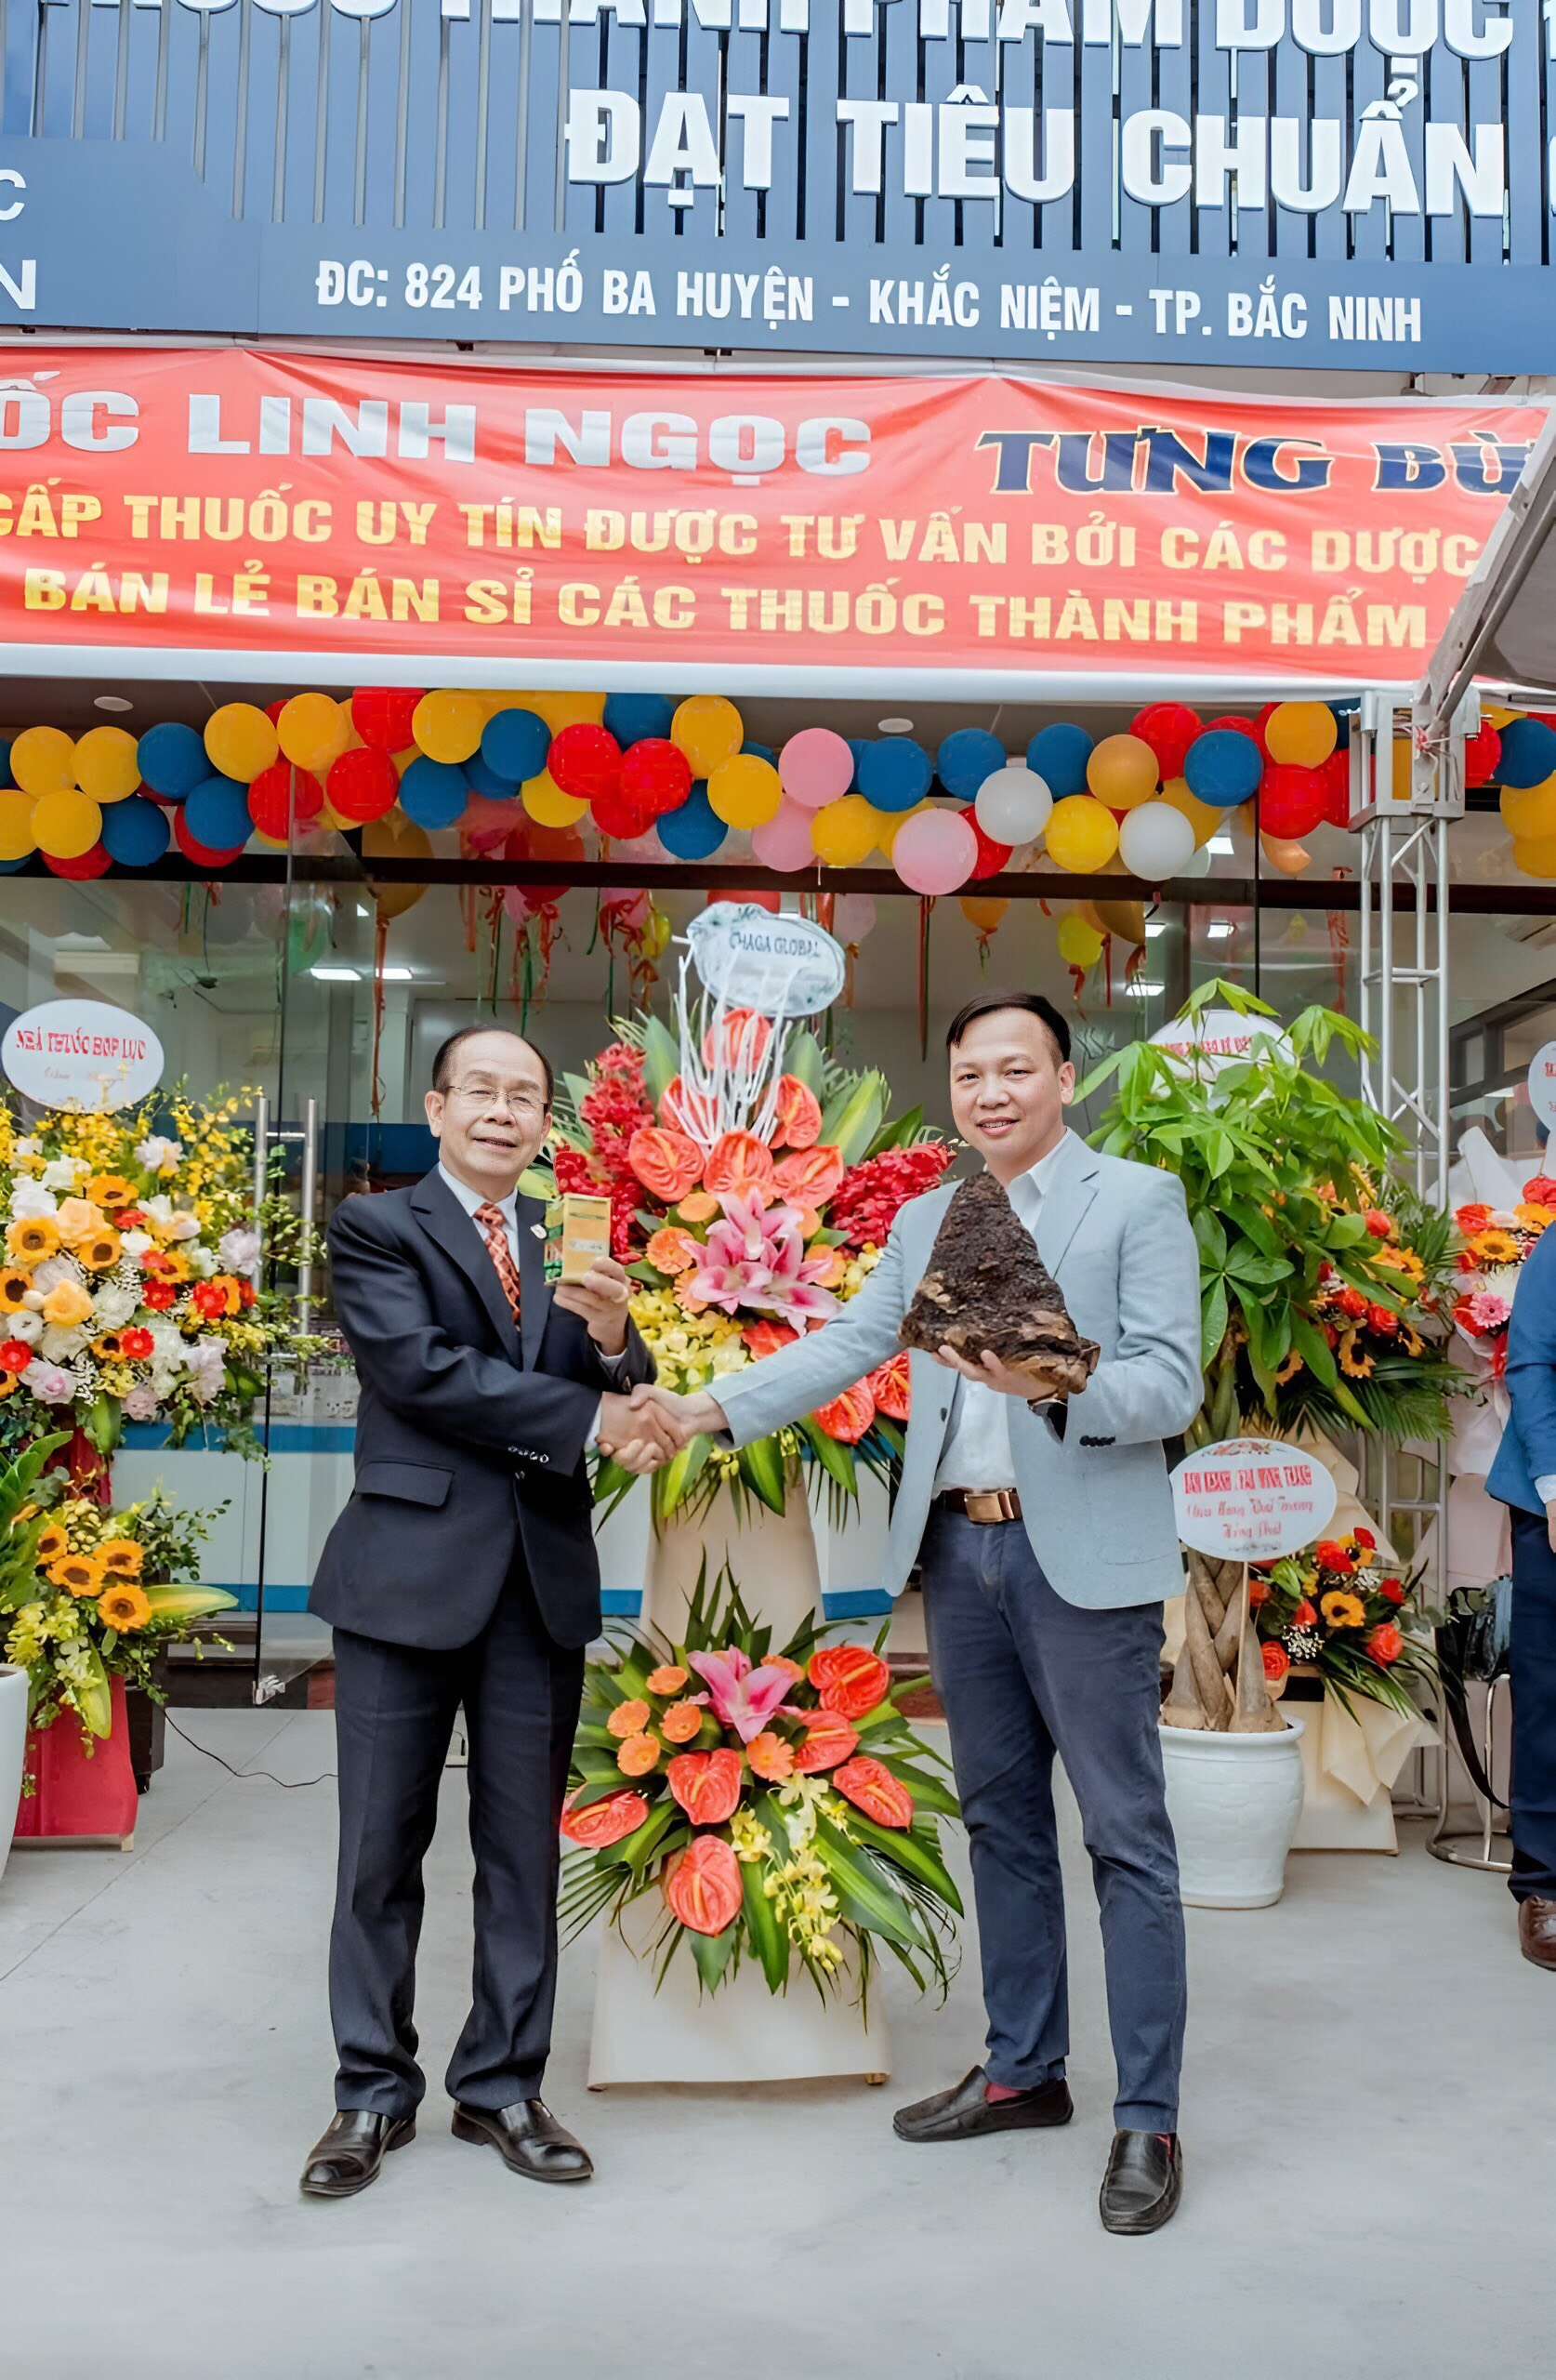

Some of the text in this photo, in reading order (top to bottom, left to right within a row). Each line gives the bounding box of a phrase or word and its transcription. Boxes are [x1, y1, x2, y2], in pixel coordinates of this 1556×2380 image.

[564, 88, 790, 209] ĐẠT
[837, 85, 1075, 204] TIÊU
[1122, 79, 1505, 217] CHUẨN
[314, 248, 1421, 342] ĐC: 824 PHỐ BA HUYỆN - KHẮC NIỆM - TP. BẮC NINH
[189, 394, 476, 464] LINH
[525, 409, 870, 486] NGỌC
[124, 483, 333, 543] THUỐC
[357, 501, 438, 546] UY
[458, 496, 562, 549] TÍN
[584, 509, 758, 564] ĐƯỢC
[781, 514, 865, 560] TƯ
[880, 506, 1008, 564] VẤN
[1032, 511, 1137, 567] BỞI
[1161, 521, 1287, 572] CÁC
[1312, 527, 1481, 585] DƯỢC
[25, 562, 170, 614] BÁN
[194, 560, 271, 615] LẺ
[297, 567, 440, 622] BÁN
[559, 575, 696, 629] CÁC
[725, 576, 945, 636] THUỐC
[969, 589, 1198, 643] THÀNH
[1224, 587, 1427, 648] PHẨM
